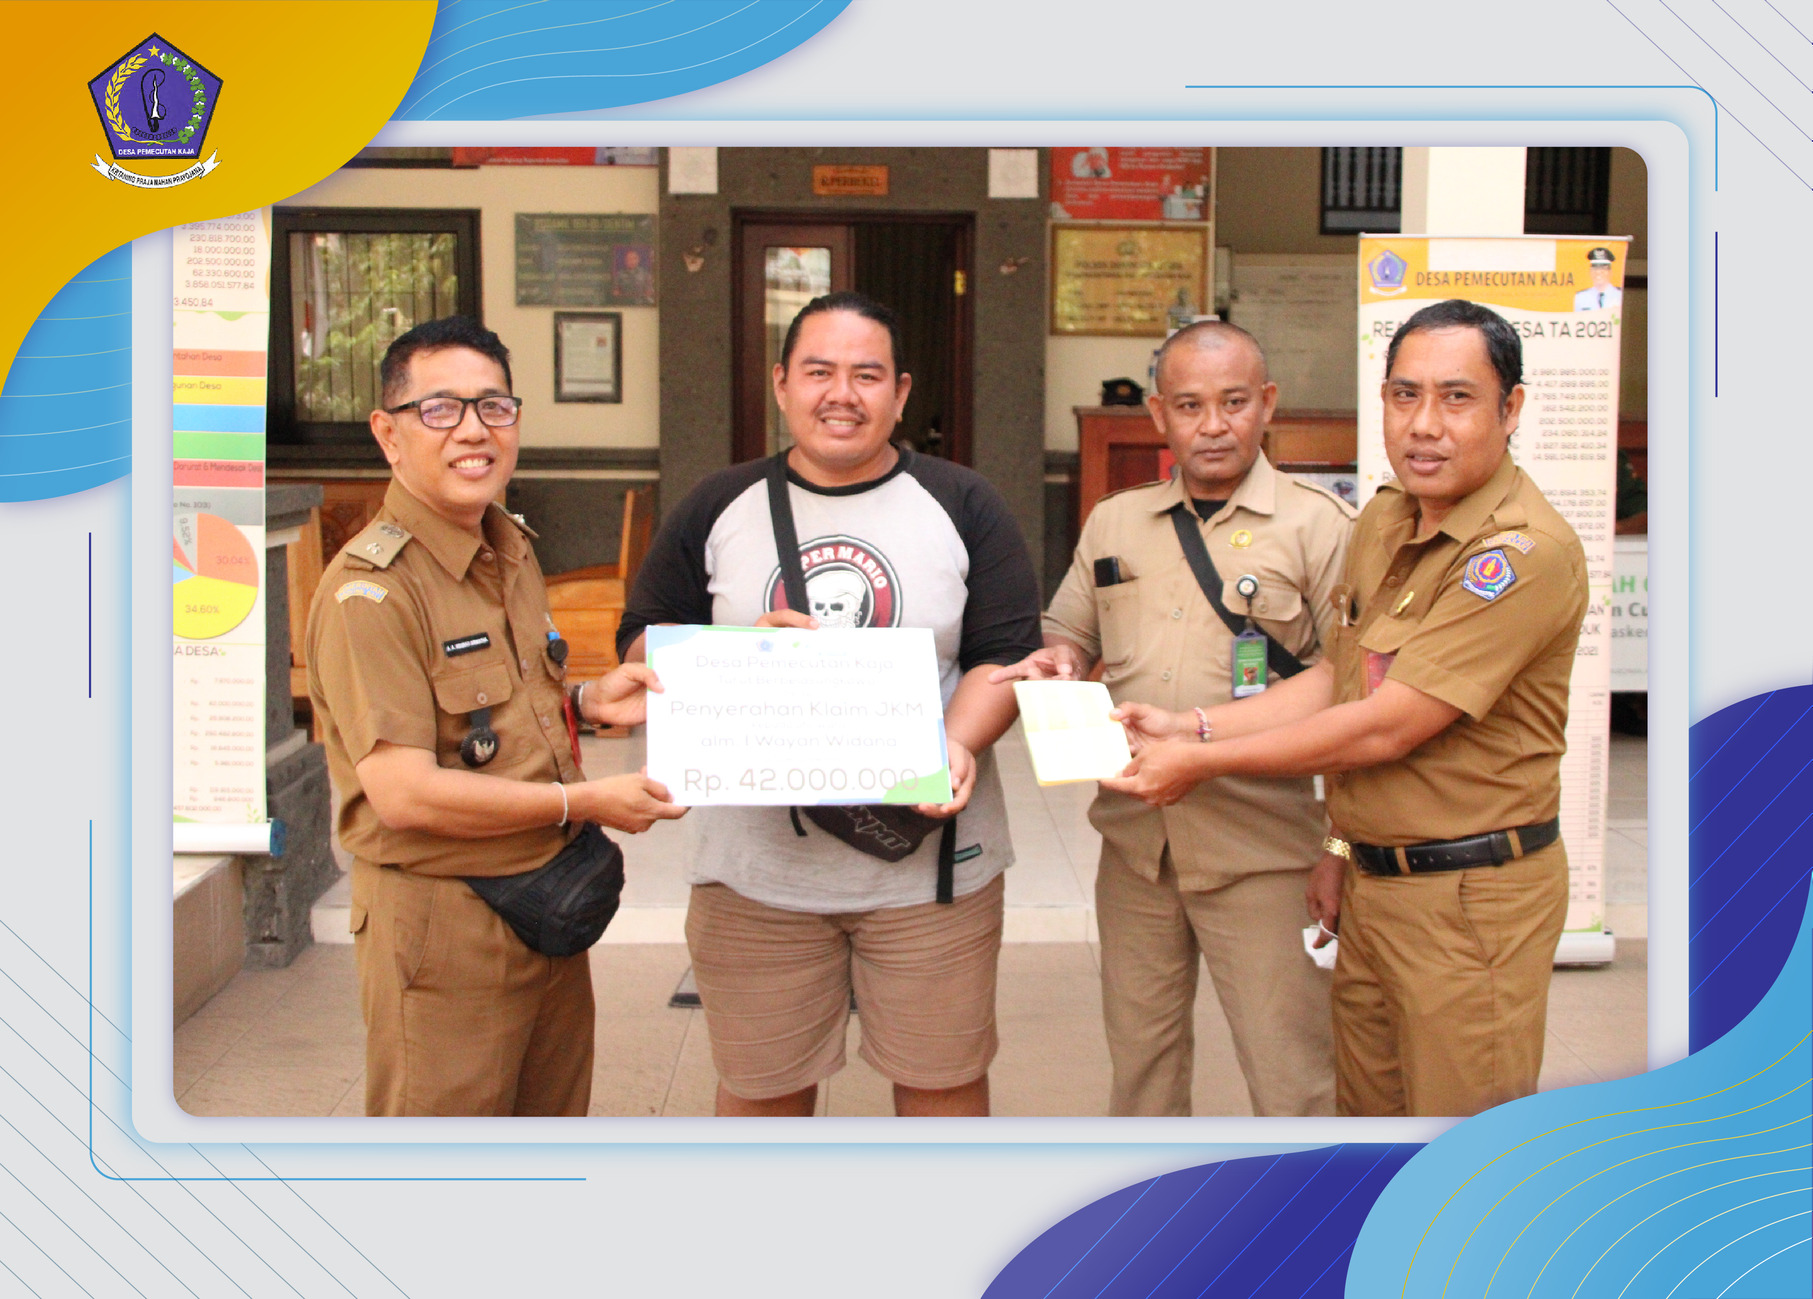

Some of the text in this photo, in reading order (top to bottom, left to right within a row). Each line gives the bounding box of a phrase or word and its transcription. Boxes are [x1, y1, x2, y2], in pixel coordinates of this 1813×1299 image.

[1416, 271, 1575, 288] DESA PEMECUTAN KAJA
[1372, 320, 1402, 338] RE
[1549, 321, 1572, 338] TA
[1575, 321, 1613, 338] 2021
[199, 380, 222, 391] Desa
[837, 545, 889, 590] MARIO
[186, 646, 219, 657] DESA
[696, 655, 894, 674] Desa Pemecutan Kaja
[670, 700, 924, 719] Penyerahan Klaim JKM
[756, 735, 817, 750] Wayan
[826, 734, 898, 748] Widana
[684, 768, 919, 798] Rp. 42.000.000
